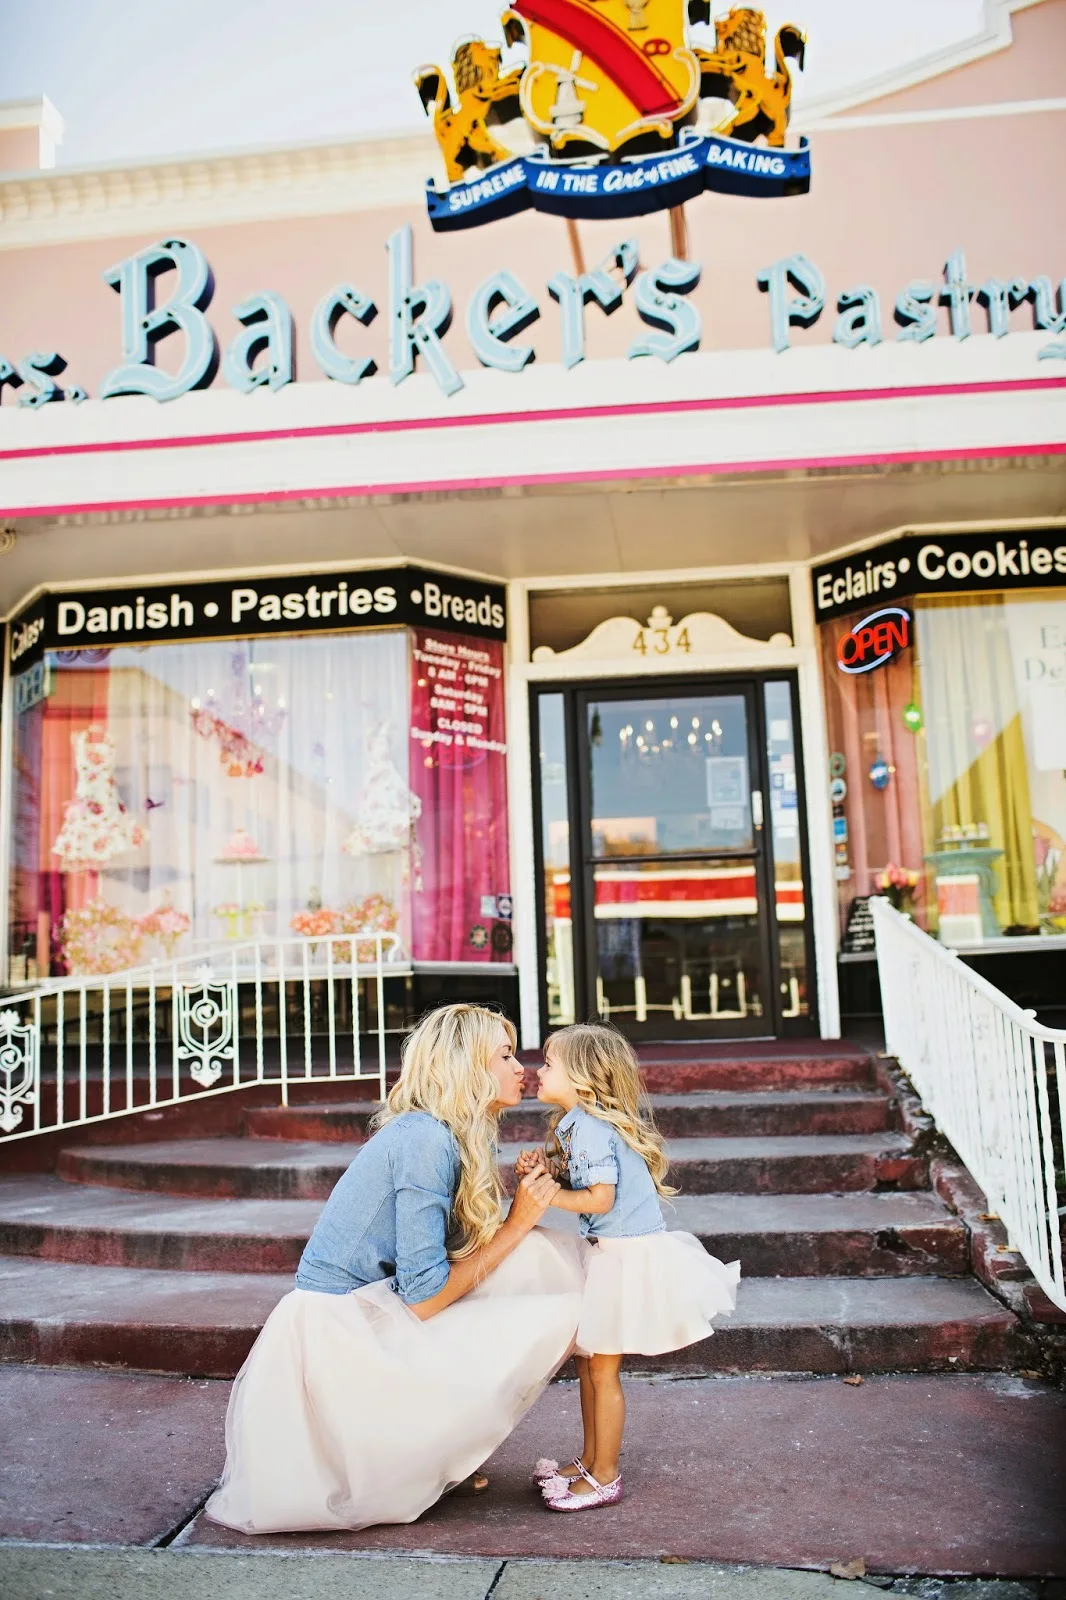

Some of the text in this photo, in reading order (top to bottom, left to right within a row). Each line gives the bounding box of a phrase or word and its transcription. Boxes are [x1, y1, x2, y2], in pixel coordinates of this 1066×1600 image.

[448, 165, 527, 212] SUPREME
[536, 169, 558, 191] IN
[562, 170, 598, 193] THE
[658, 153, 699, 180] FINE
[707, 144, 786, 175] BAKING
[101, 222, 701, 403] Backer's
[817, 540, 1066, 610] Eclairs Cookies
[57, 593, 194, 636] Danish
[230, 581, 398, 624] Pastries
[424, 582, 505, 629] Breads
[425, 638, 490, 662] Store Hours
[632, 627, 693, 656] 434
[837, 616, 909, 665] OPEN
[413, 649, 460, 671] Tuesday
[468, 660, 501, 679] Friday
[434, 683, 484, 705] Saturday
[411, 726, 508, 755] Sunday & Monday
[437, 717, 483, 735] CLOSED
